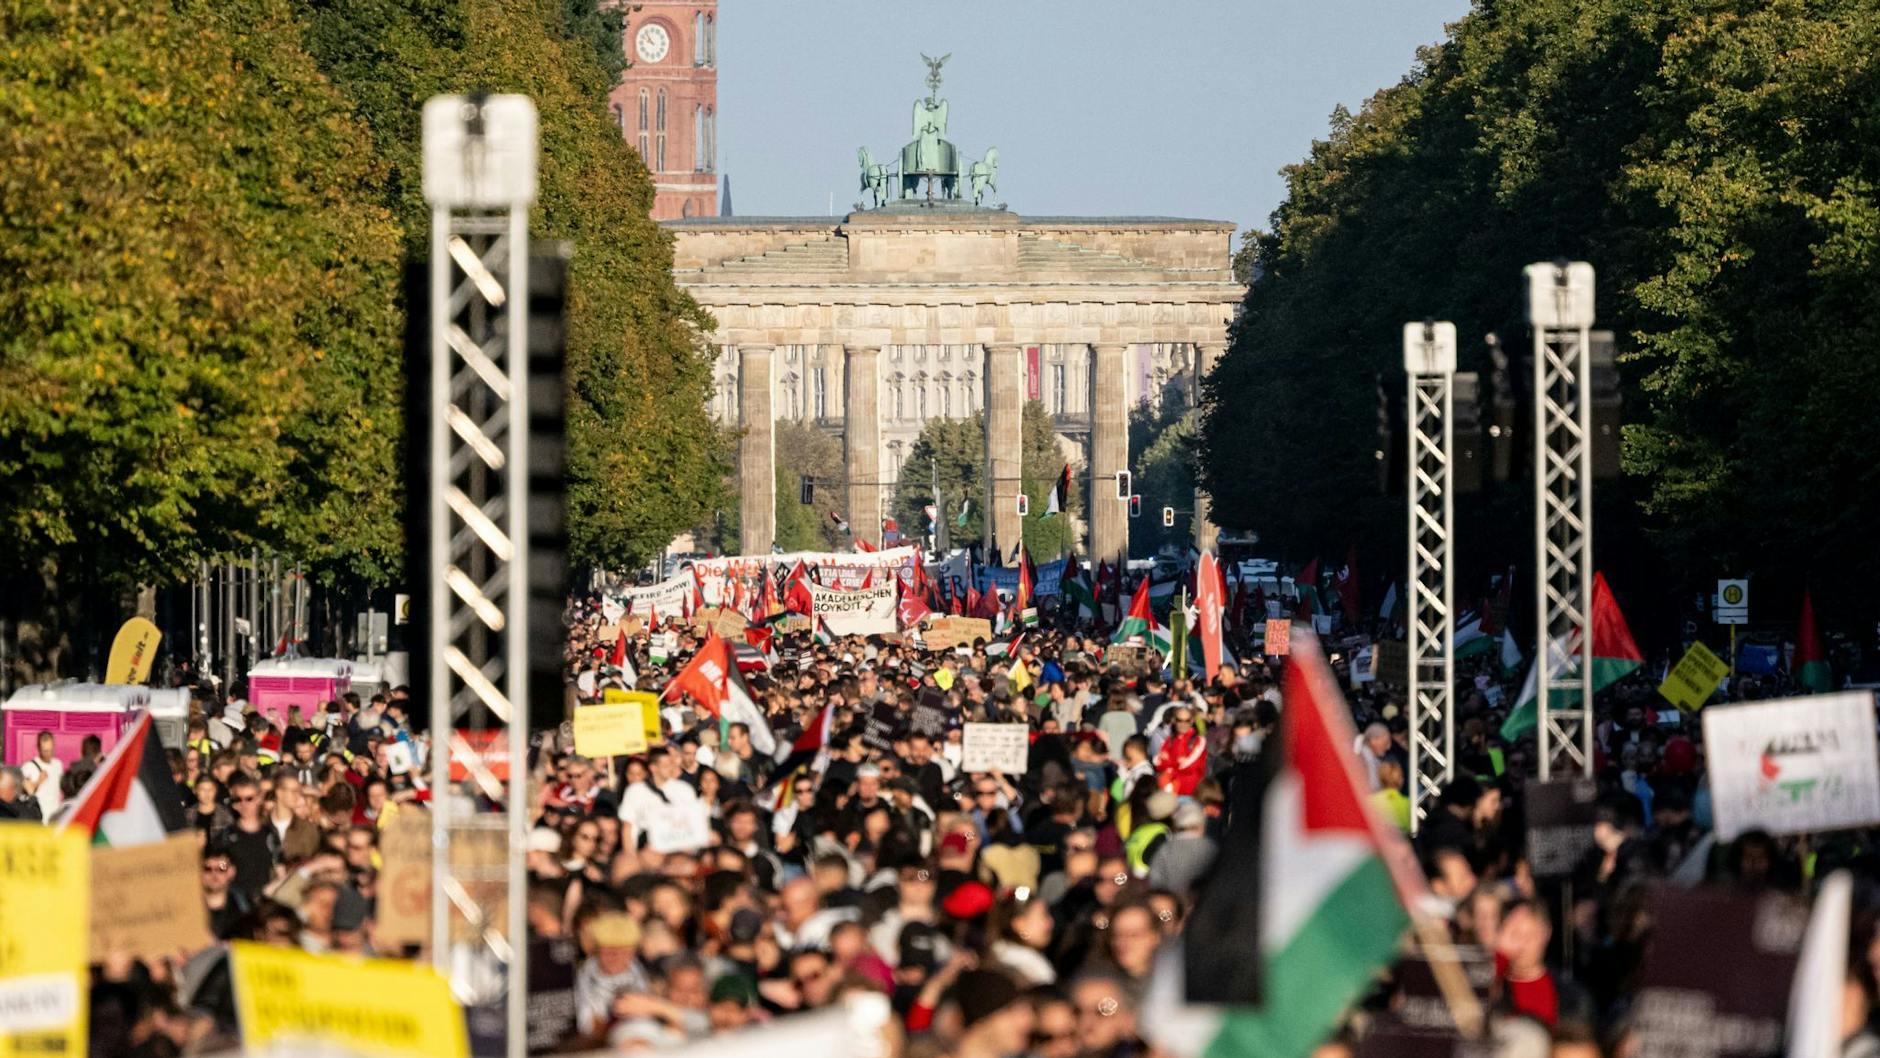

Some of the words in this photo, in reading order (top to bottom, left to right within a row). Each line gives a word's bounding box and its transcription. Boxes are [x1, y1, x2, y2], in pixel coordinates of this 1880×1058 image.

[697, 563, 722, 577] Die
[815, 589, 891, 602] AKADEMISCHEN
[1729, 588, 1737, 600] H
[814, 602, 860, 612] BOYKOTT
